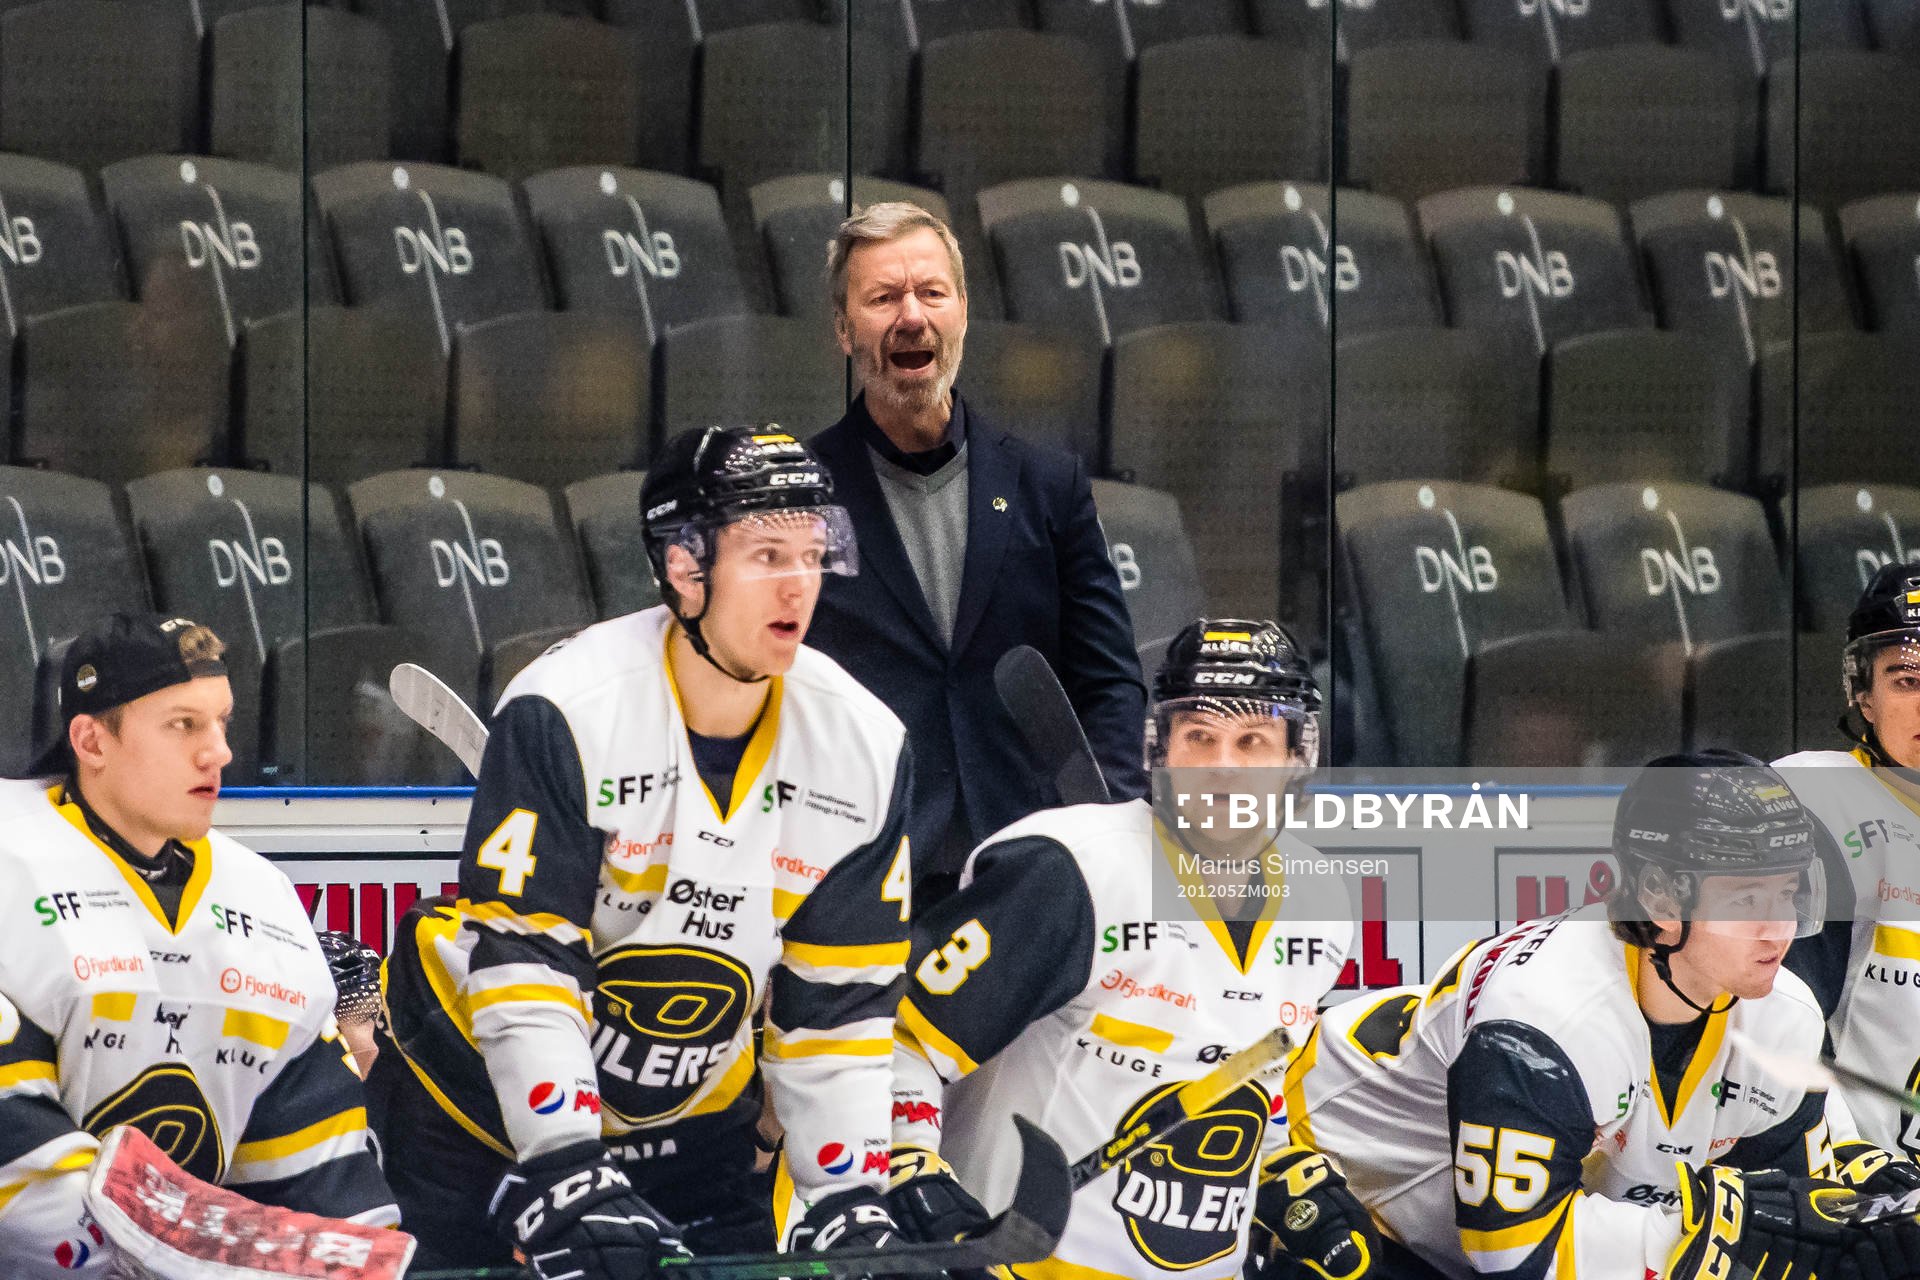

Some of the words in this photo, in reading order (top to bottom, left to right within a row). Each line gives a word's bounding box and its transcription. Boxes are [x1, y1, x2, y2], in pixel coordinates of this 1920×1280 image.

[181, 219, 262, 269] DNB
[394, 226, 473, 275] DNB
[604, 230, 682, 279] DNB
[1058, 241, 1142, 289] DNB
[1280, 244, 1361, 292] DNB
[1495, 250, 1575, 299] DNB
[1704, 251, 1783, 299] DNB
[768, 472, 821, 486] CCM
[209, 537, 292, 588] DNB
[430, 538, 509, 588] DNB
[1415, 545, 1498, 594] DNB
[1641, 547, 1721, 596] DNB
[1194, 672, 1256, 685] CCM
[595, 774, 654, 808] SFF
[477, 808, 538, 897] 4
[1628, 829, 1669, 843] CCM
[1769, 831, 1809, 848] CCM
[34, 891, 82, 927] SFF
[667, 879, 744, 912] Øster
[210, 903, 253, 938] SFF
[681, 910, 735, 940] Hus
[1101, 922, 1158, 953] SFF
[1273, 935, 1324, 966] SFF
[1222, 988, 1263, 1001] CCM
[1076, 1037, 1163, 1079] KLUGE
[1454, 1120, 1556, 1213] 55
[514, 1166, 632, 1243] CCM
